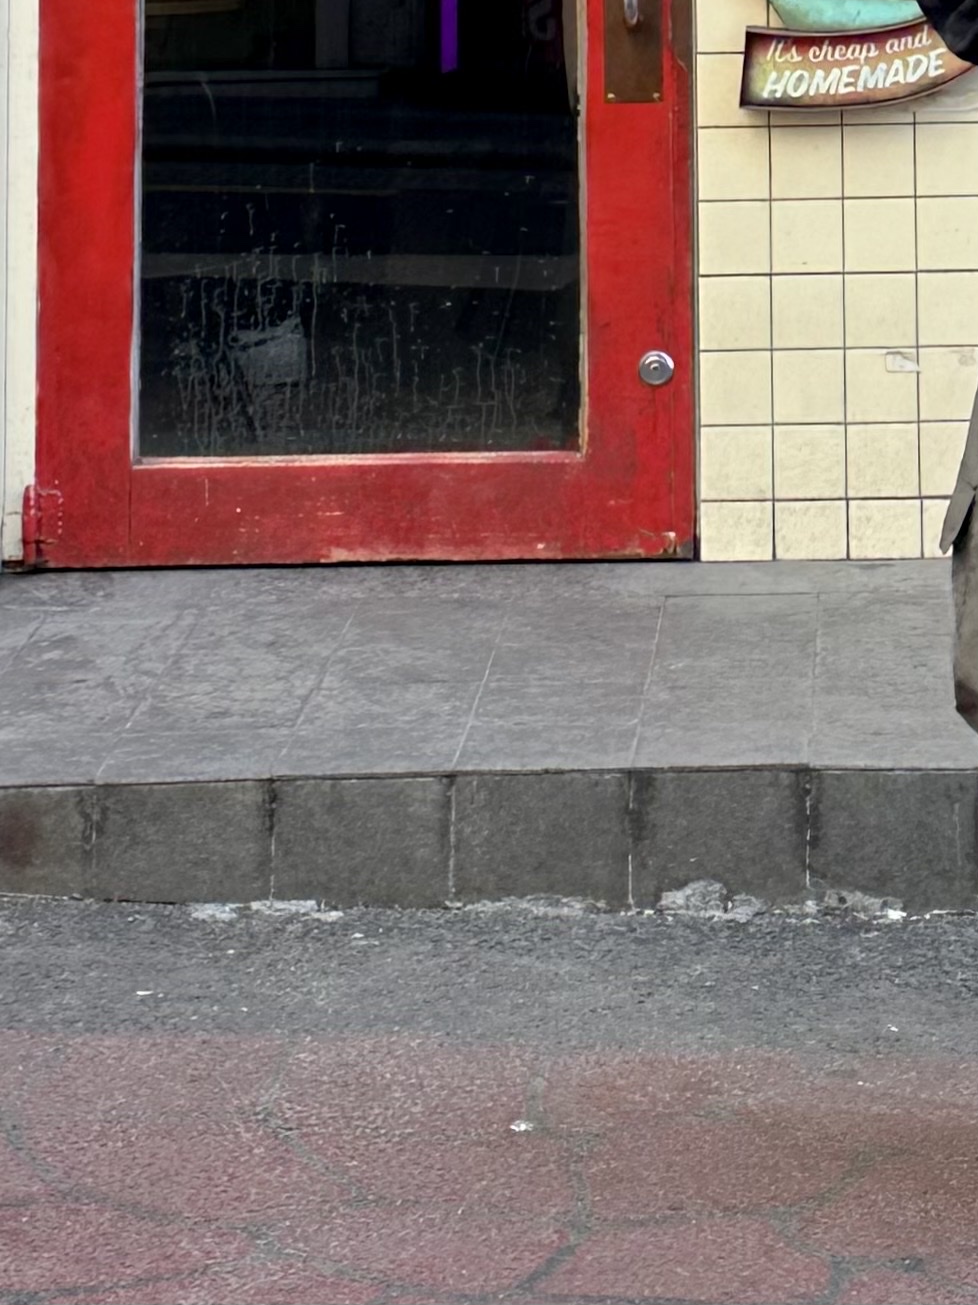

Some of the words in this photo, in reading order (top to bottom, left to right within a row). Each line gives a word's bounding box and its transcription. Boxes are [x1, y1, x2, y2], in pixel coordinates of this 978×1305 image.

[809, 37, 878, 64] cheap
[885, 25, 931, 52] and
[762, 47, 948, 99] HOMEMADE
